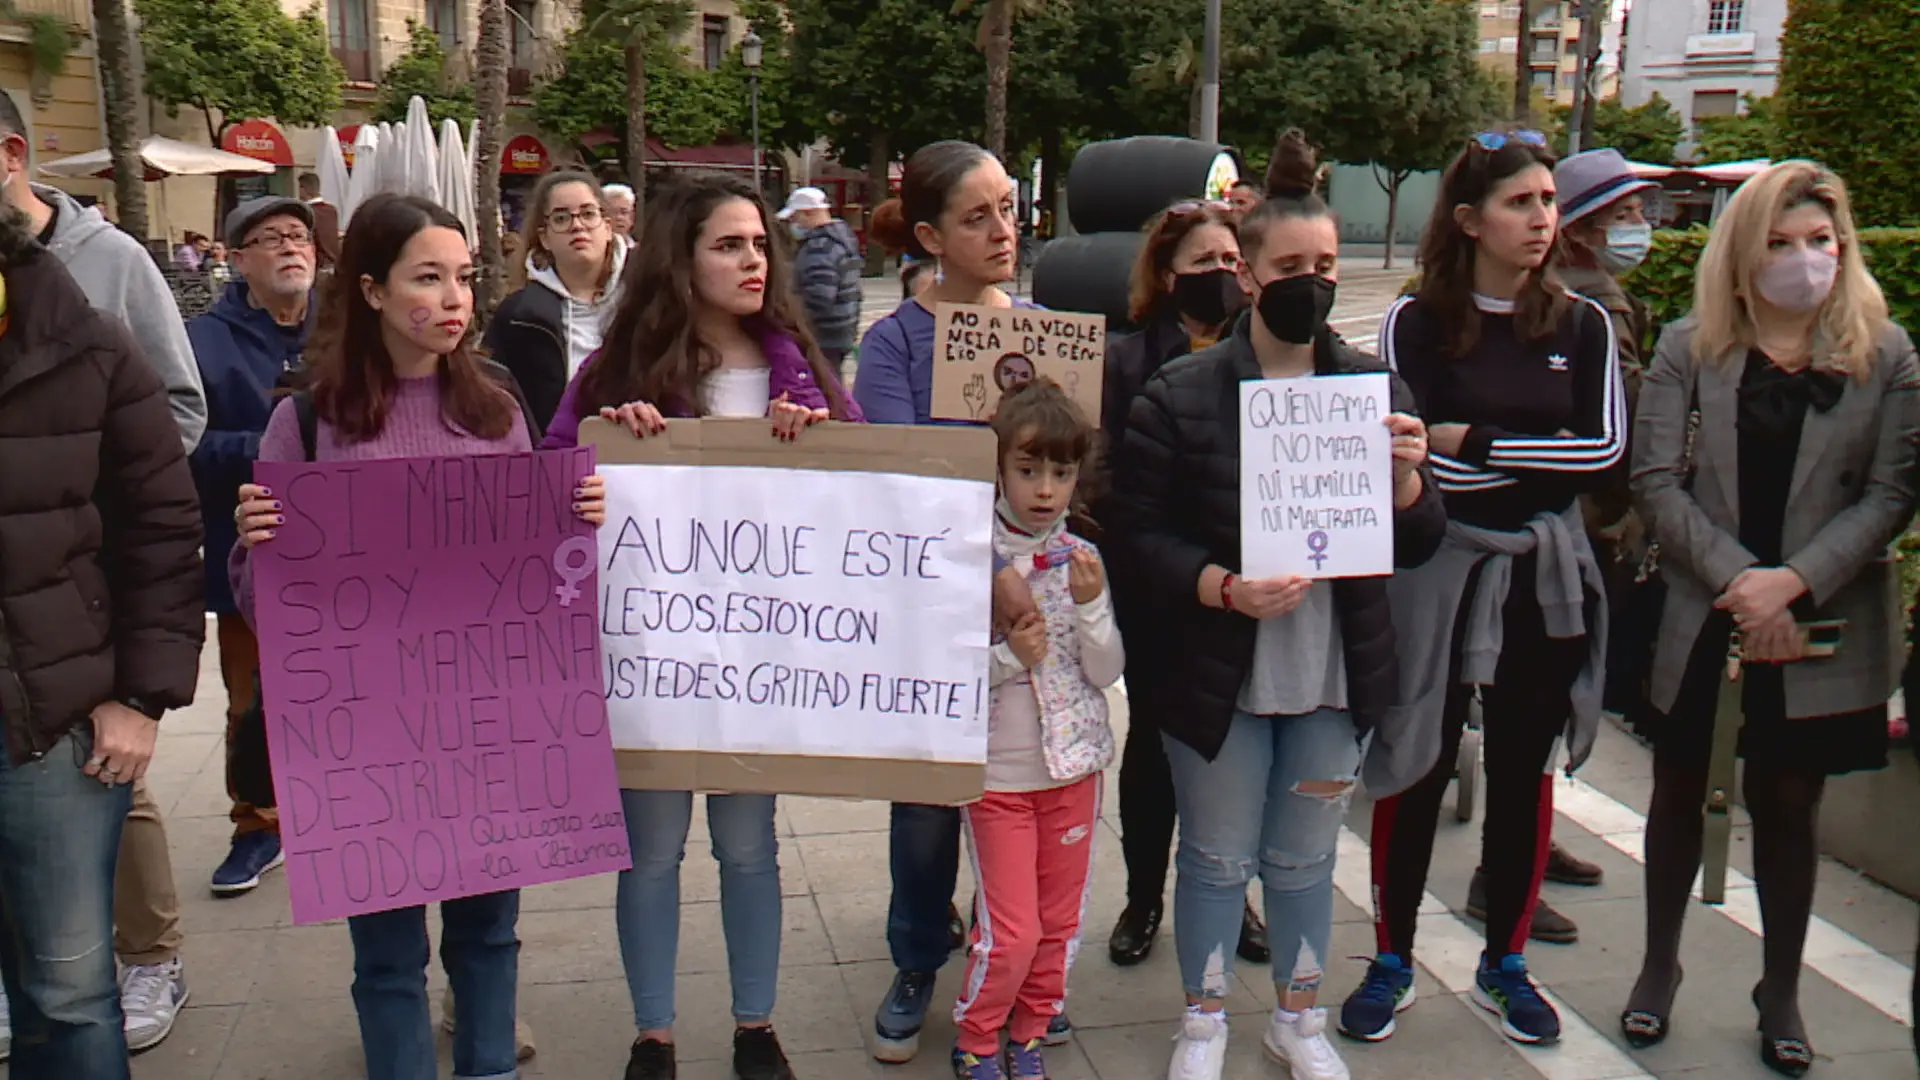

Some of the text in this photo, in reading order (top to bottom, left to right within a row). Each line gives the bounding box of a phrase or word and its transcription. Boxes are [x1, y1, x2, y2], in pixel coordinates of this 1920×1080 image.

[1012, 317, 1033, 332] LA
[1023, 335, 1046, 355] DE
[1329, 391, 1378, 423] AMA
[1272, 431, 1368, 463] NO MATA
[277, 468, 367, 562] SI
[1287, 505, 1379, 531] MALTRATA
[607, 515, 952, 579] AUNQUE ESTÉ
[278, 554, 551, 637] SOY YO
[282, 643, 369, 704] SI
[281, 690, 606, 764] NO VUELVO
[471, 811, 625, 847] Quiero ser
[293, 822, 465, 905] TODO!
[479, 851, 521, 879] la
